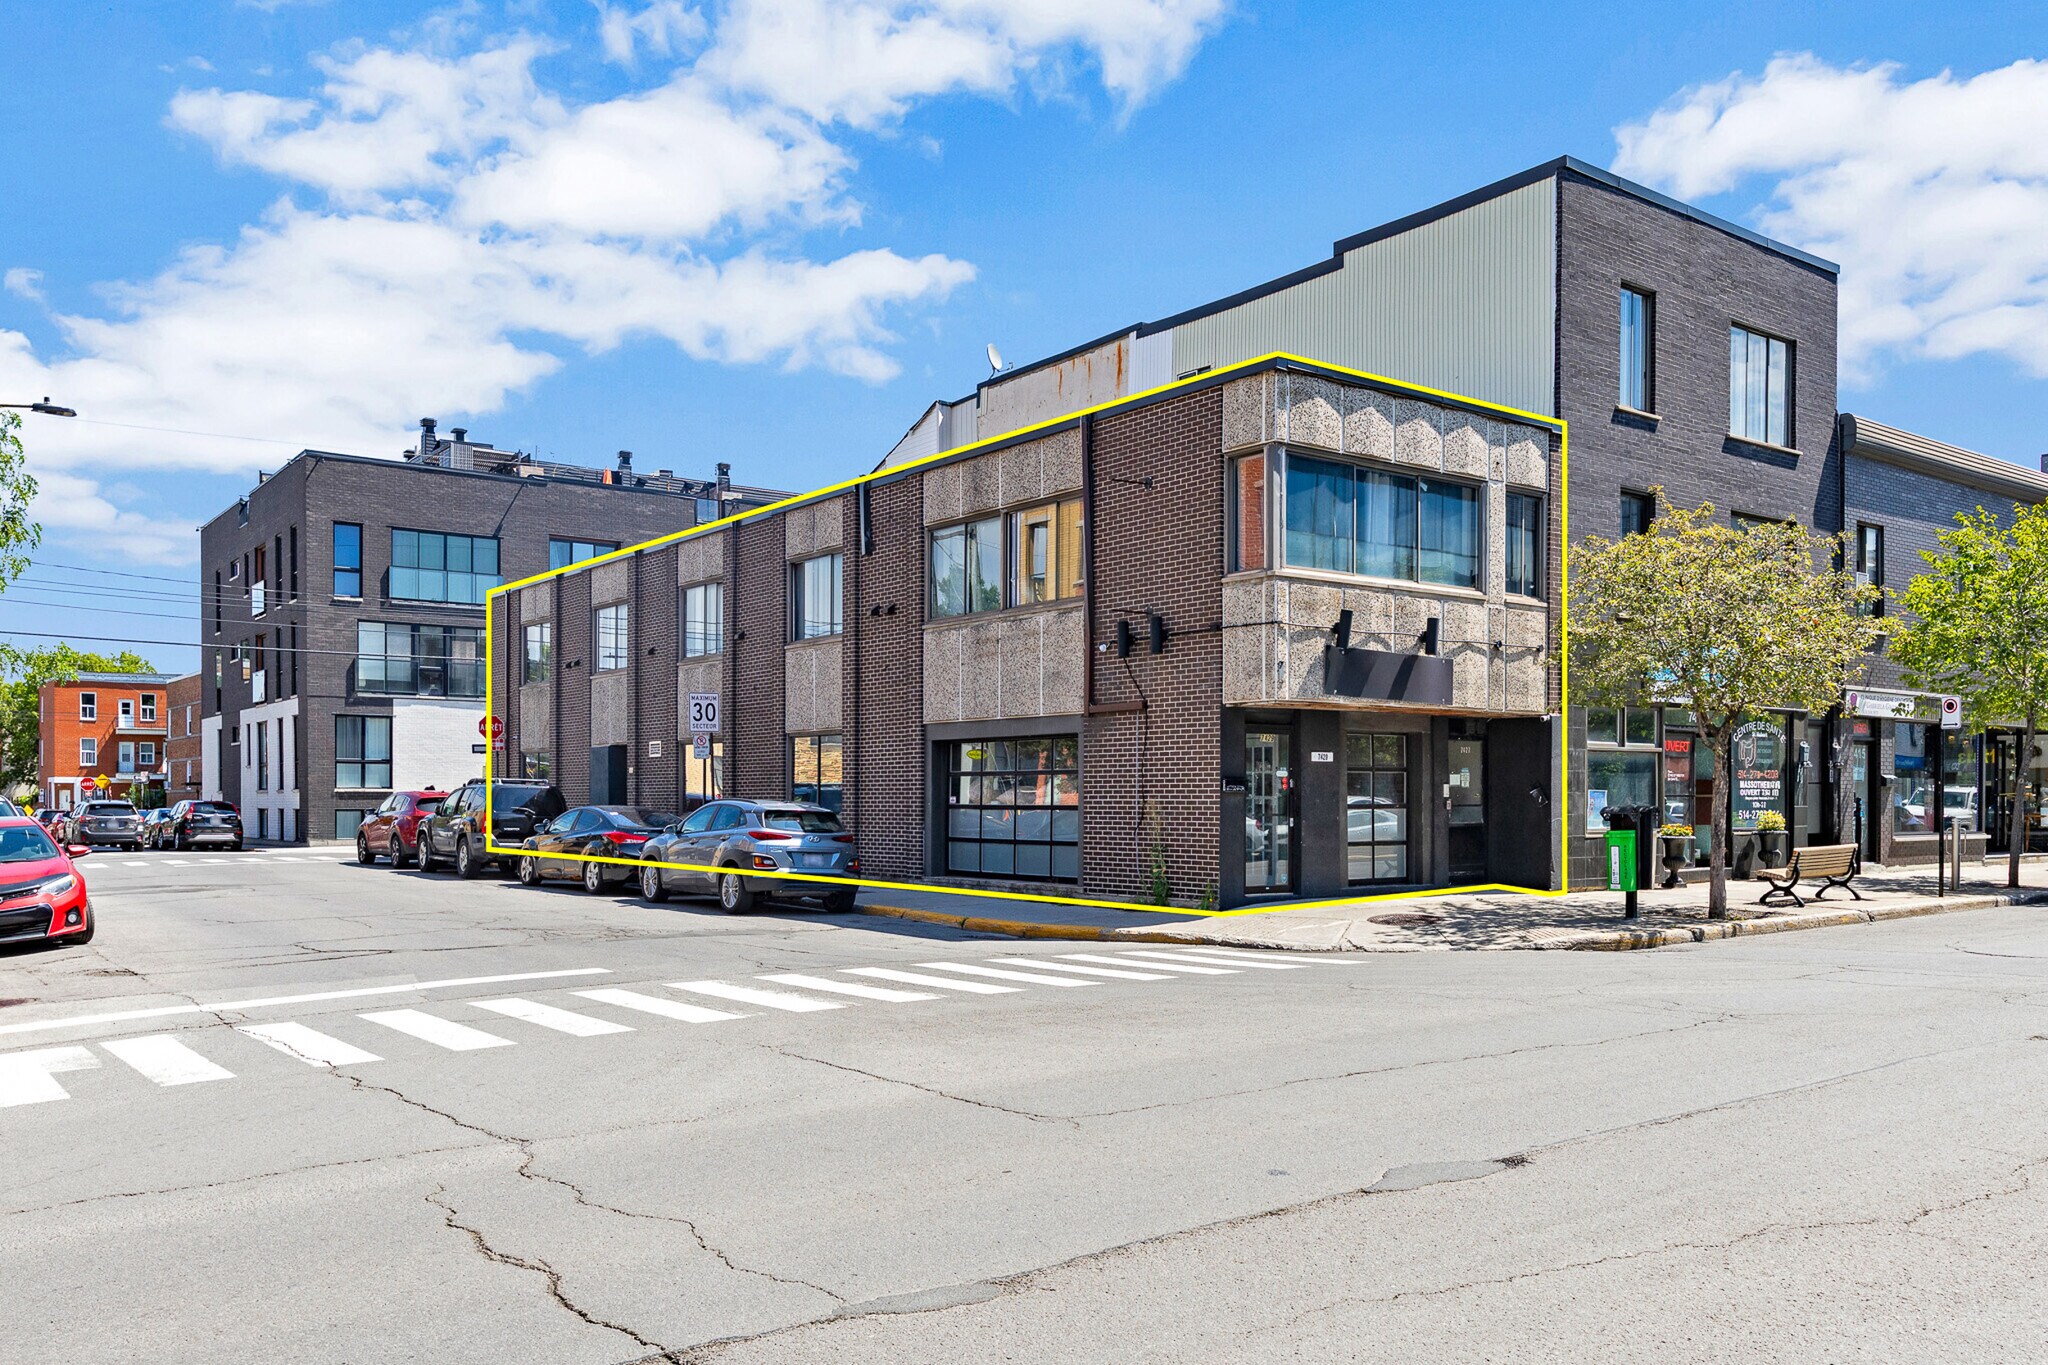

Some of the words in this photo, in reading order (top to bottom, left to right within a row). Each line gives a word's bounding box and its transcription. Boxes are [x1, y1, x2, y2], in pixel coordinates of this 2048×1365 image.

[692, 702, 716, 722] 30
[479, 723, 503, 732] ARÊT
[1733, 721, 1757, 742] CENTRE
[1757, 721, 1766, 731] DE
